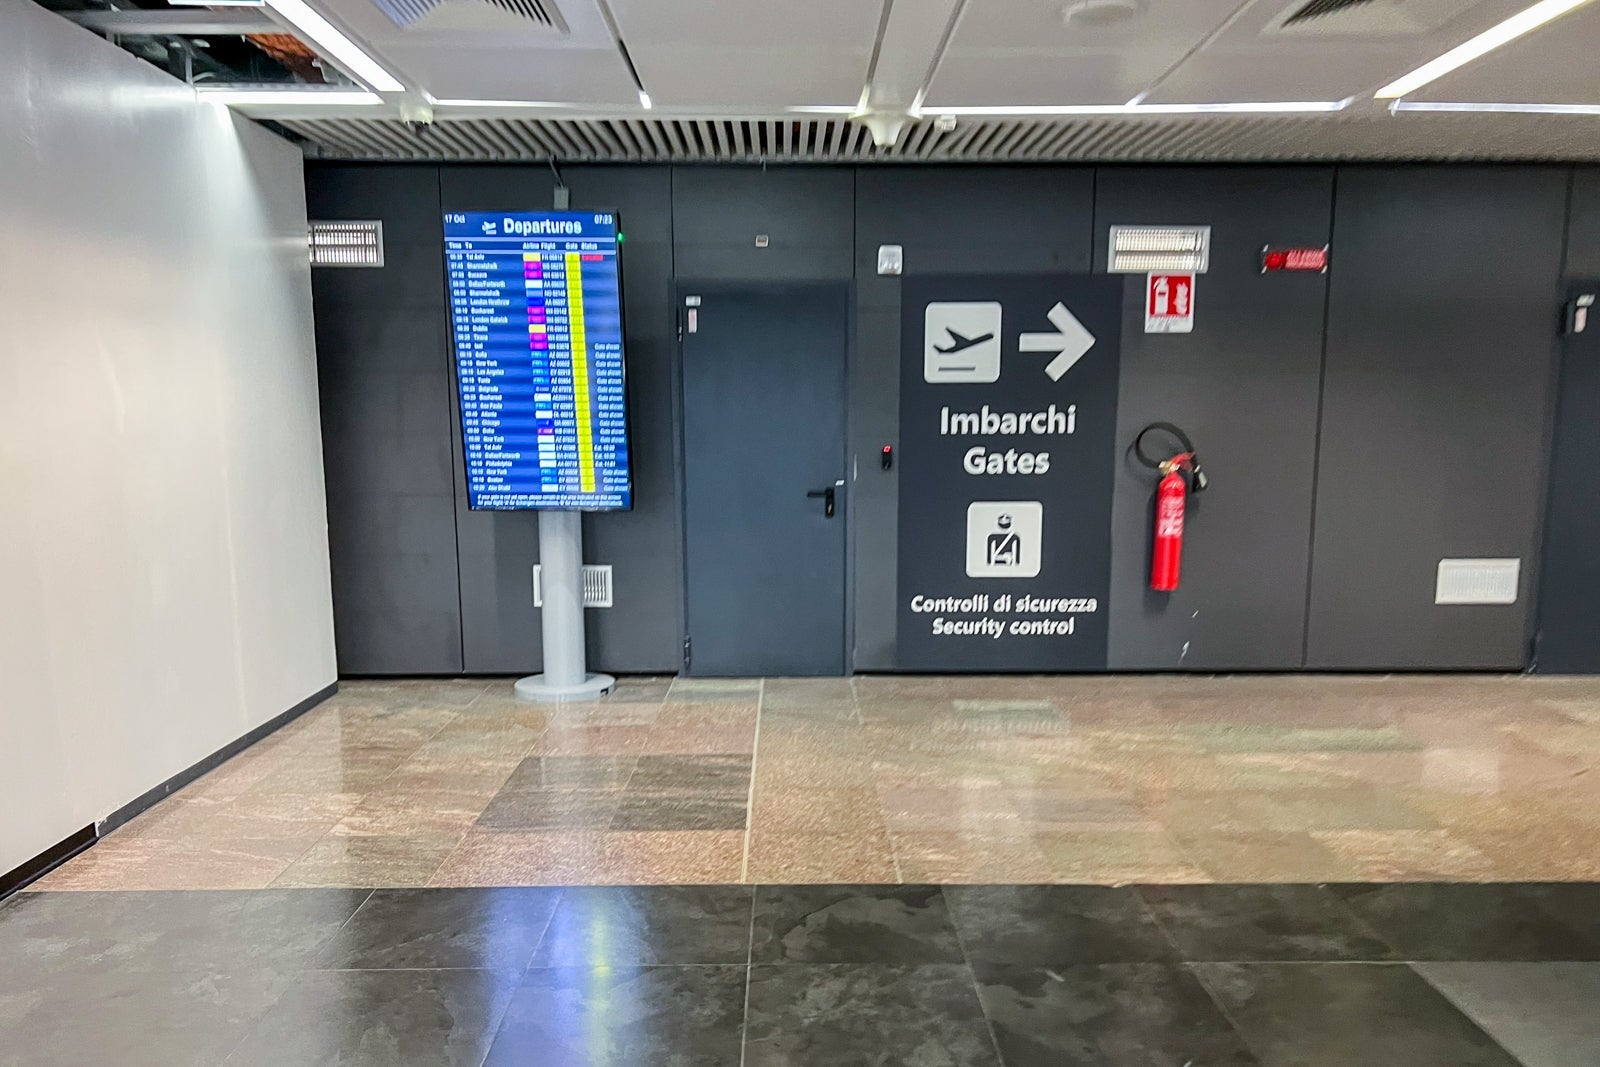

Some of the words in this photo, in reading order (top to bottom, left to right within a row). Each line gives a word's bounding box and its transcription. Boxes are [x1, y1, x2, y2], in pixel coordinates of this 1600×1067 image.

[504, 218, 582, 236] Departures
[940, 404, 1076, 436] Imbarchi
[963, 446, 1050, 475] Gates
[910, 594, 988, 613] Controlli
[993, 594, 1011, 613] di
[1015, 595, 1098, 613] sicurezza
[932, 617, 1006, 639] Security
[1010, 617, 1074, 636] control
